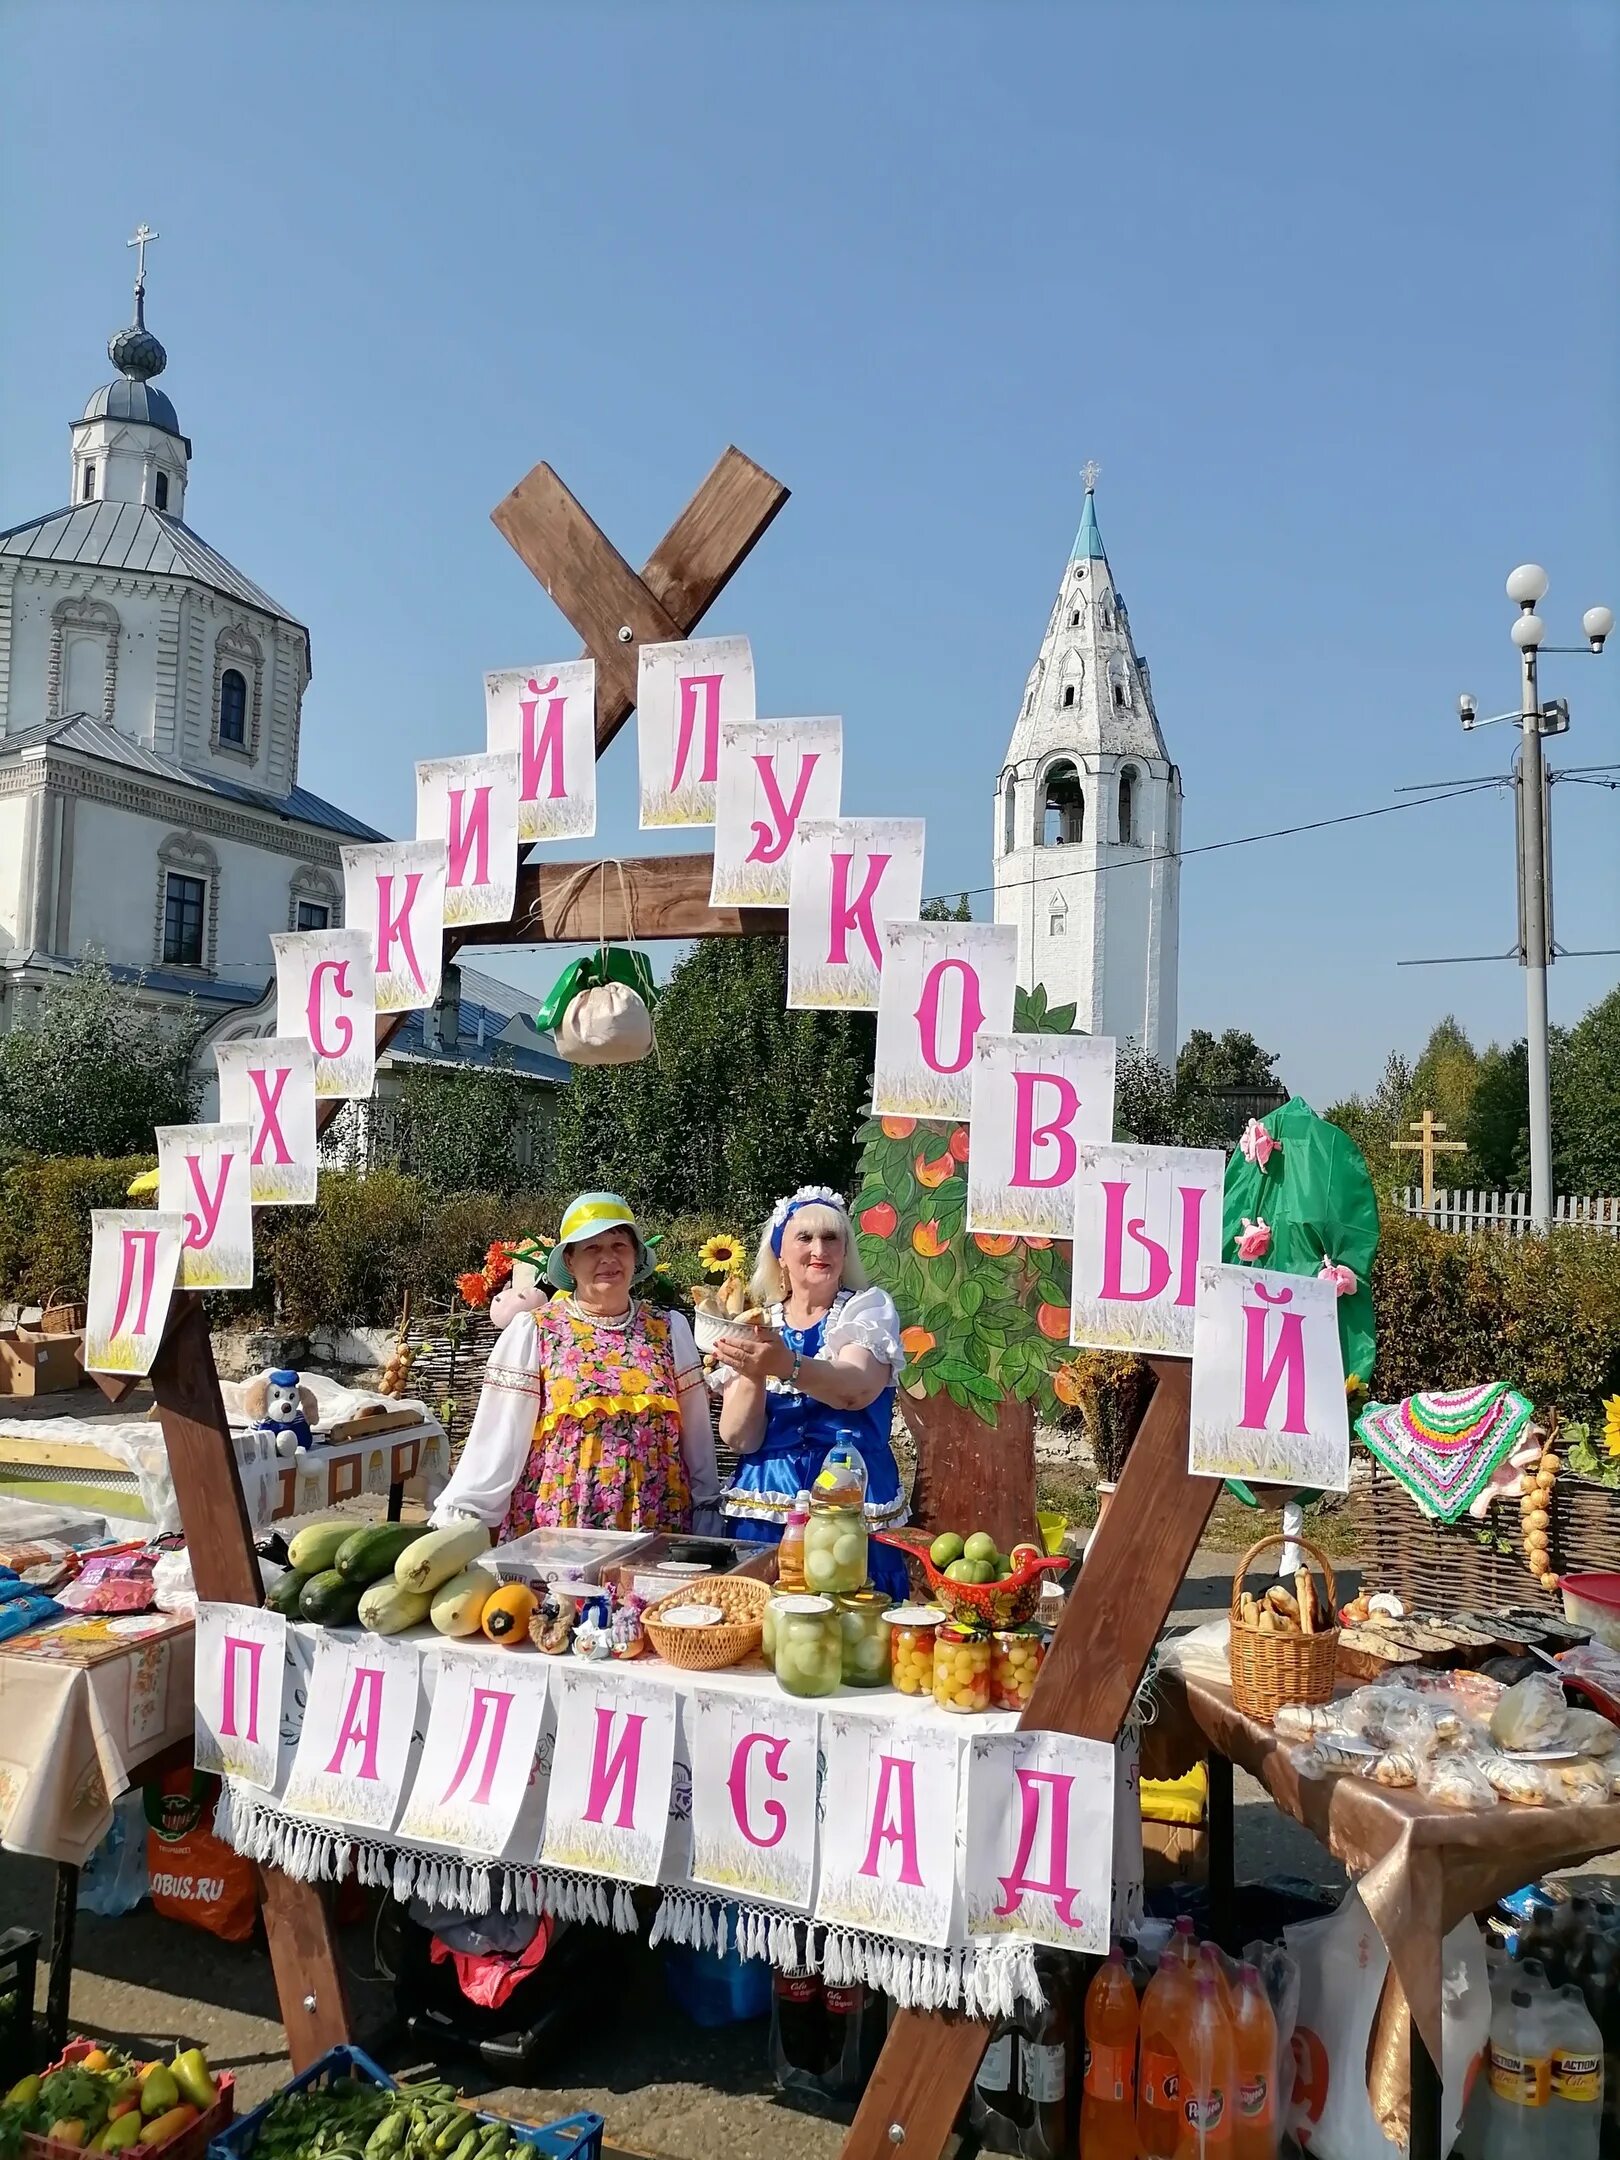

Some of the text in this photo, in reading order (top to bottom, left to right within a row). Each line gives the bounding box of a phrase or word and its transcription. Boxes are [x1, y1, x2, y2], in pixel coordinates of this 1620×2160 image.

[110, 674, 1312, 1436] ЛУХСКИЙ ЛУКОВЫЙ
[219, 1637, 1083, 1928] ПАЛИСАД
[1563, 2059, 1597, 2071] ACTION
